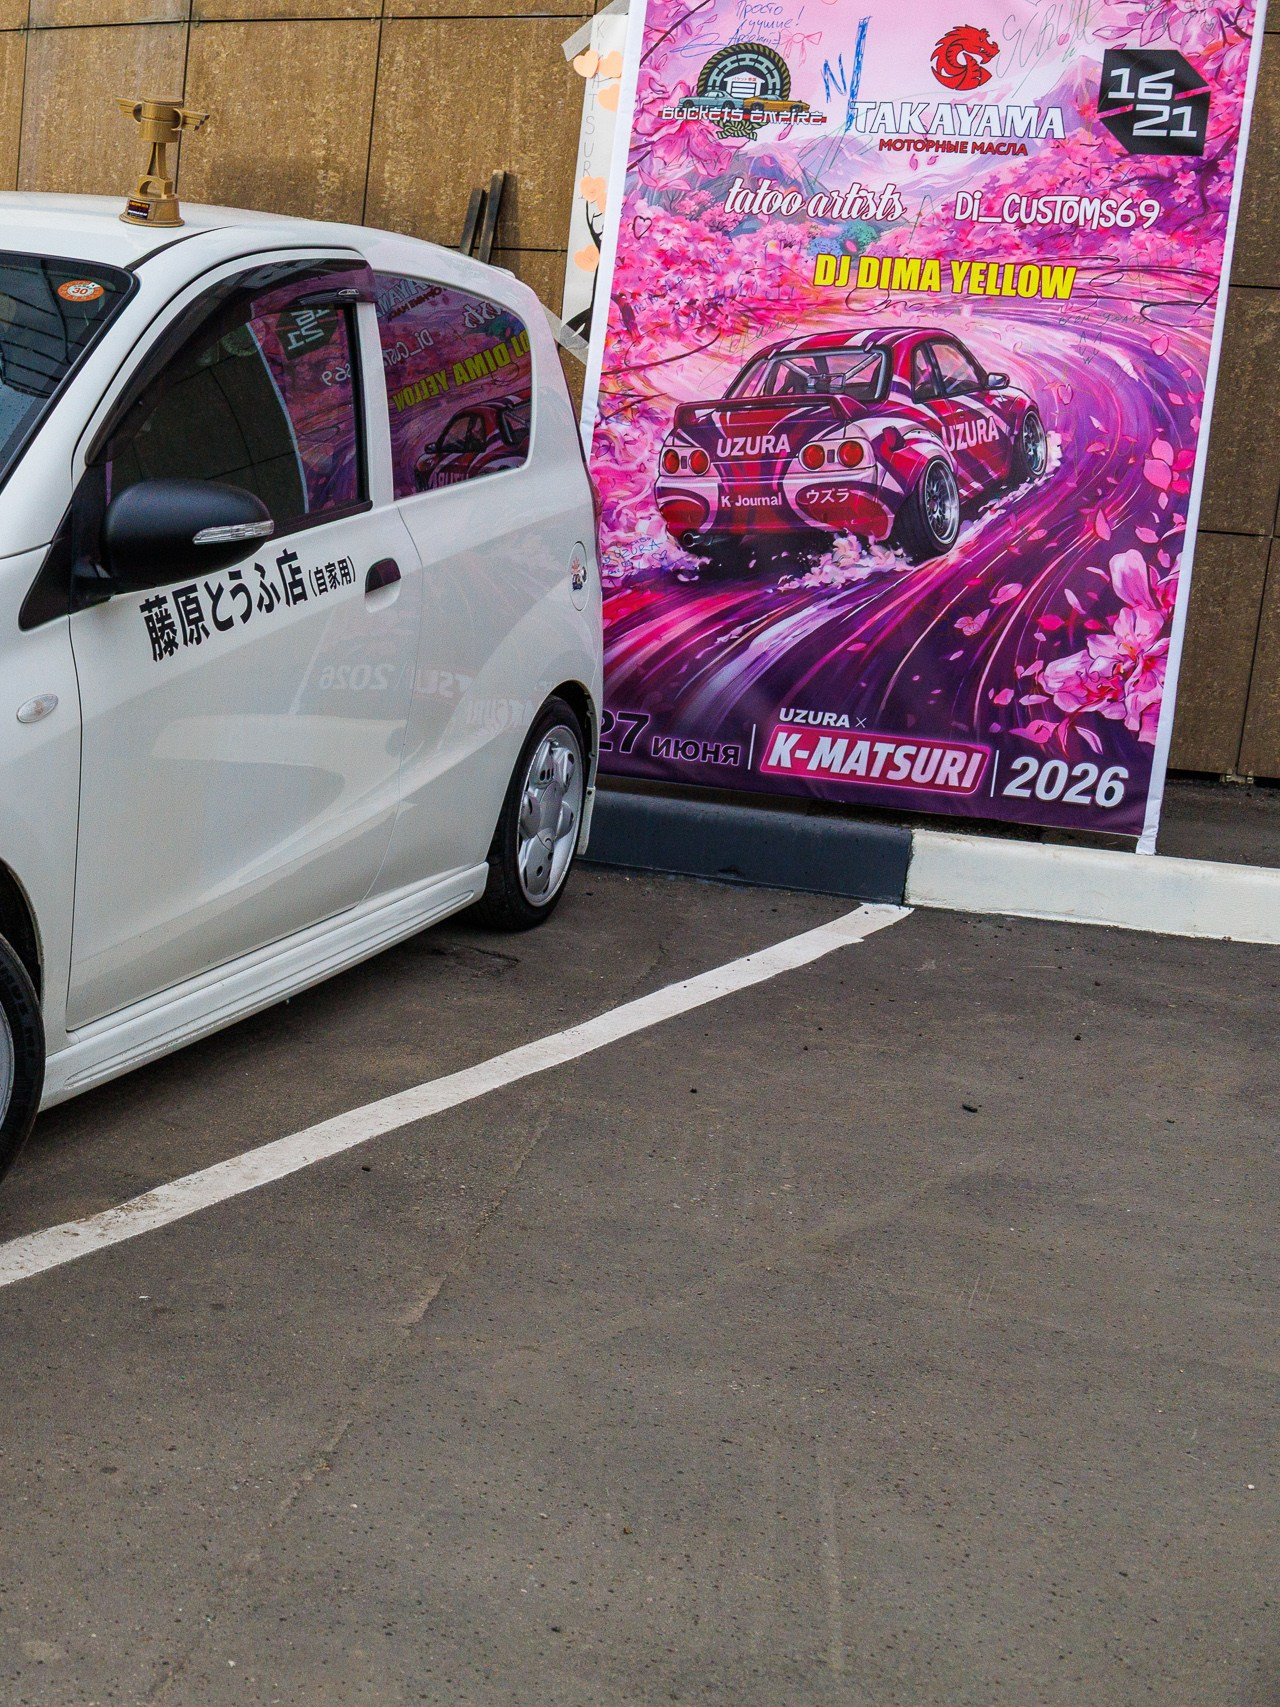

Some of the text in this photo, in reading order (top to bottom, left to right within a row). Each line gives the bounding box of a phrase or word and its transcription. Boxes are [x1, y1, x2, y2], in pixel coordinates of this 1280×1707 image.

[1108, 67, 1176, 100] 16
[850, 100, 1066, 139] TAKAYAMA
[1132, 104, 1197, 138] 21
[878, 138, 1028, 156] МОТОРНЫЕ МАСЛА
[724, 177, 908, 222] tatoo artists
[813, 253, 1078, 301] DJ DIMA YELLOW
[716, 433, 791, 458] UZURA
[941, 415, 1000, 452] UZURA
[806, 488, 851, 505] ウズラ
[598, 709, 651, 754] 27
[779, 708, 850, 728] UZURA
[768, 731, 983, 790] K-MATSURI
[1002, 756, 1130, 808] 2026
